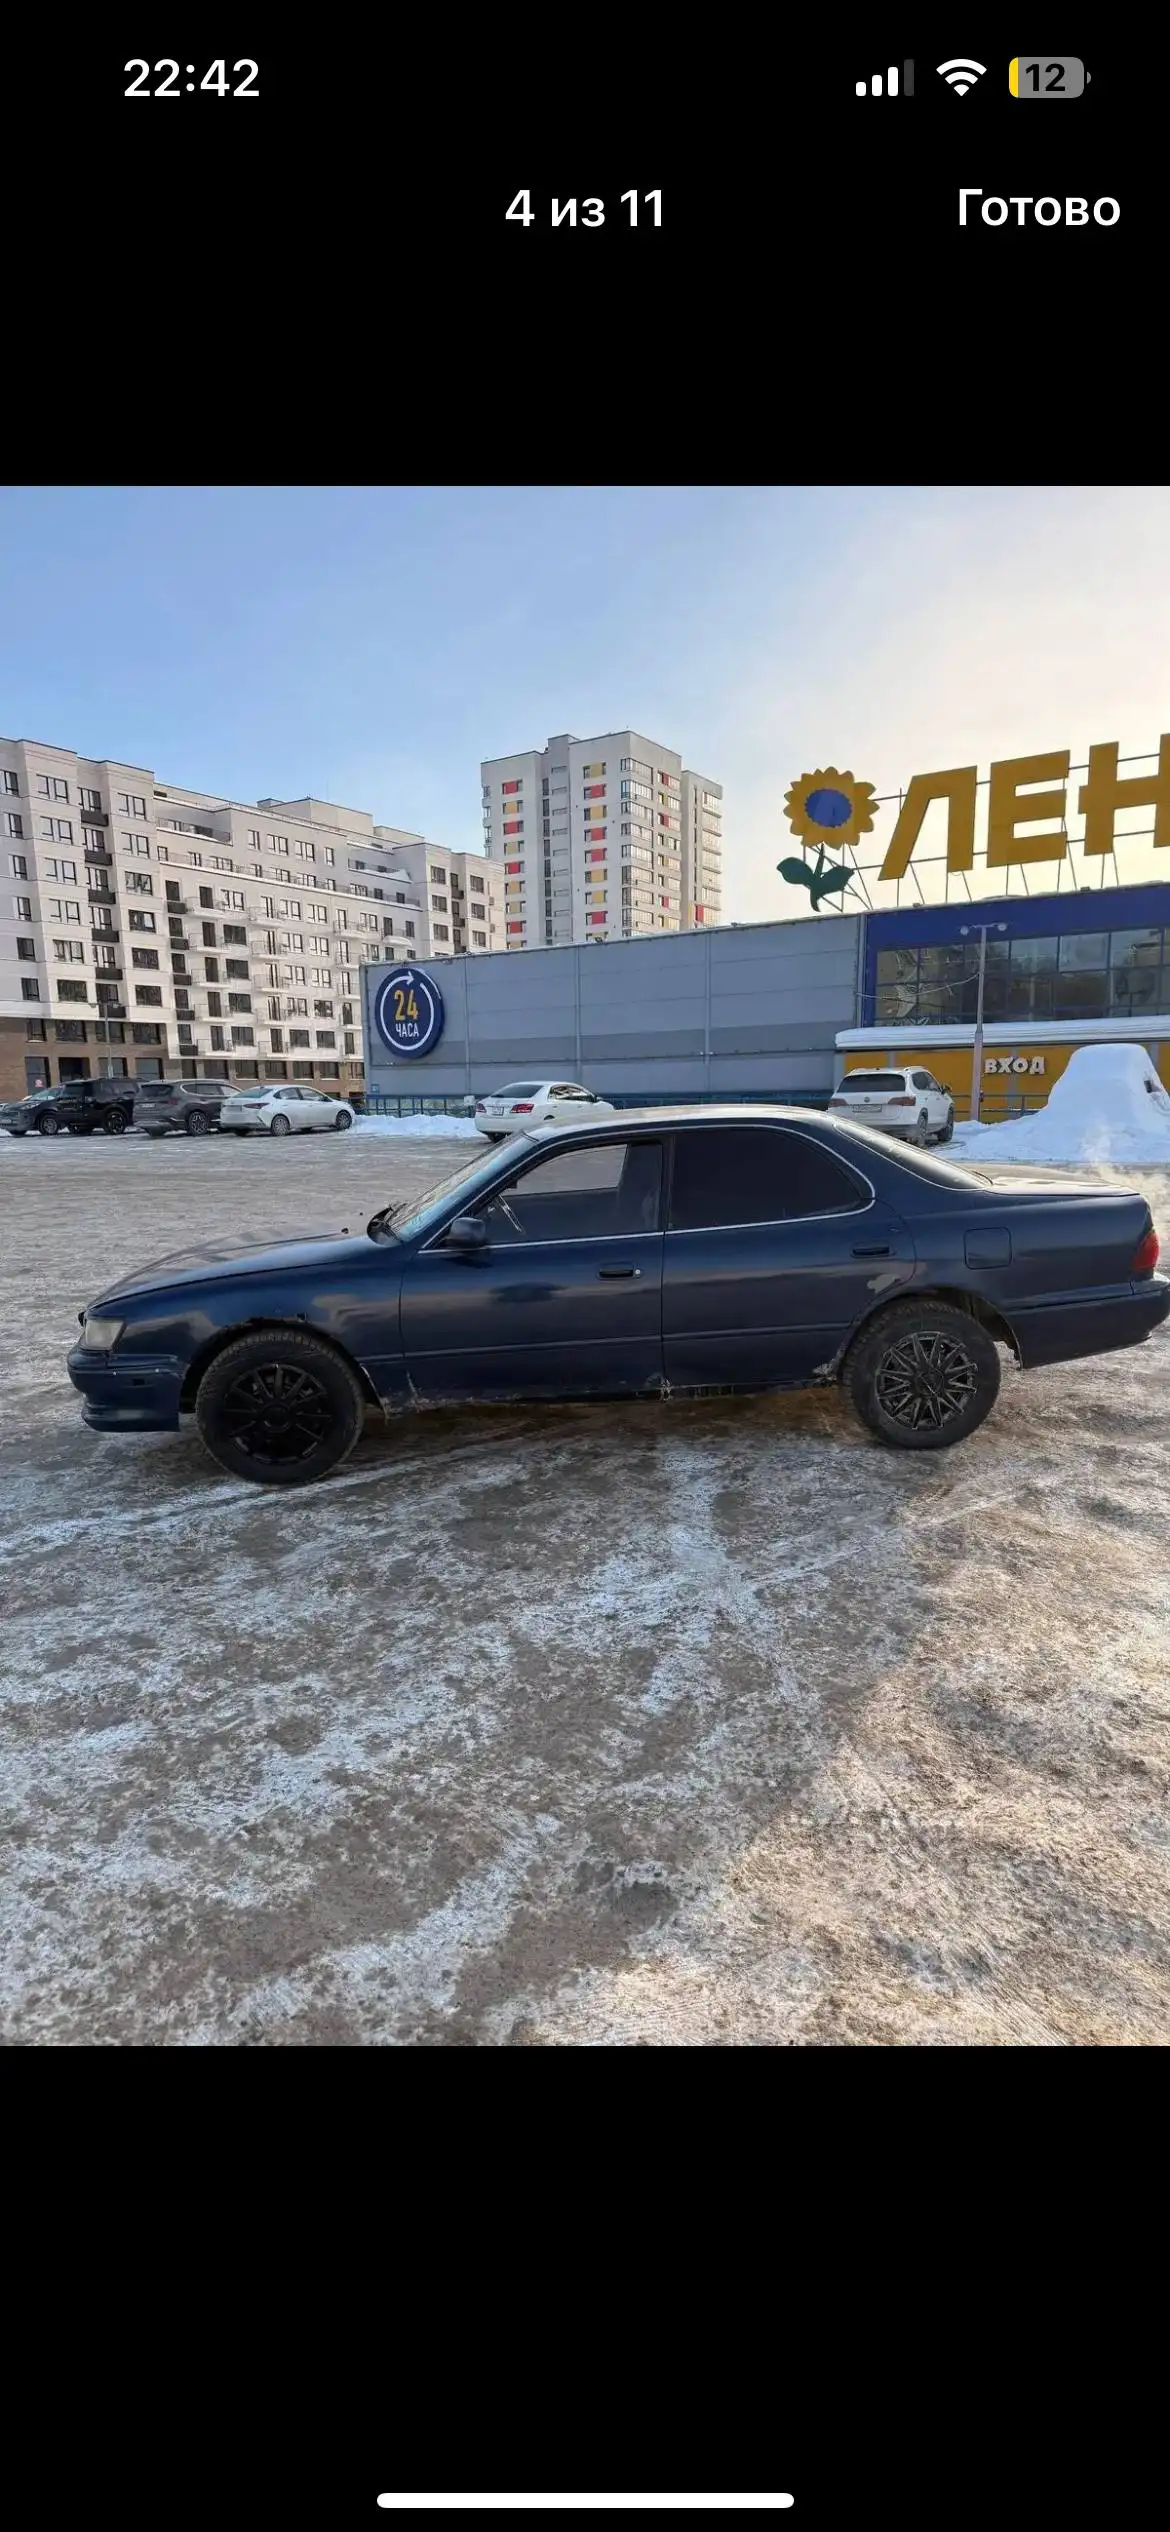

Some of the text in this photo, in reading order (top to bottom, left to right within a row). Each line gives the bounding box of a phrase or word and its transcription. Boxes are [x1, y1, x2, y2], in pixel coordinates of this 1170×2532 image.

[878, 733, 1170, 881] ЛЕН
[394, 989, 419, 1021] 24
[395, 1022, 420, 1038] ЧАСА
[984, 1056, 1045, 1075] ВХОД
